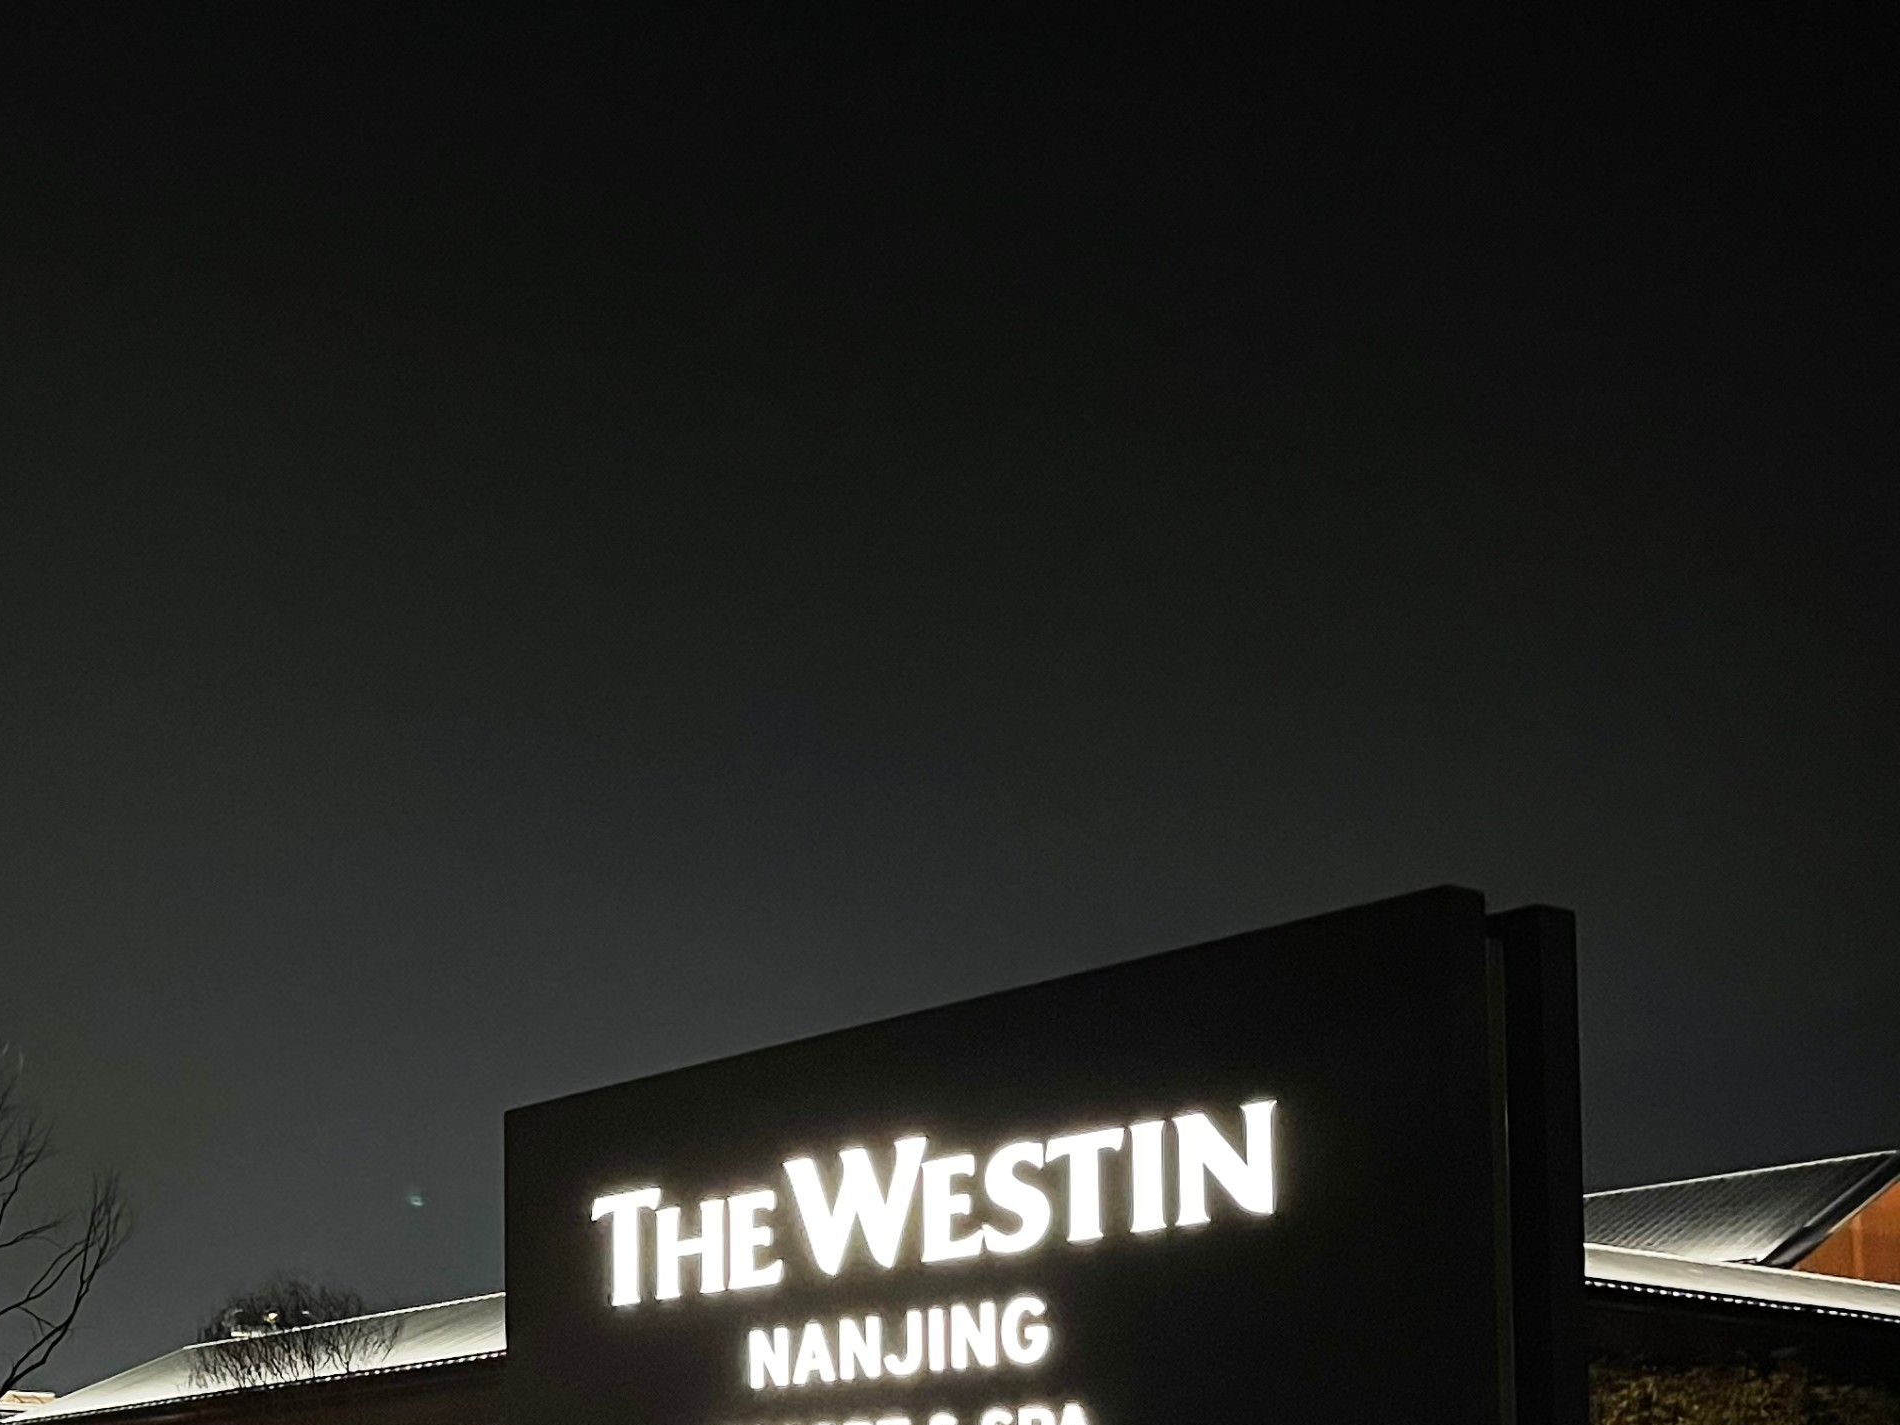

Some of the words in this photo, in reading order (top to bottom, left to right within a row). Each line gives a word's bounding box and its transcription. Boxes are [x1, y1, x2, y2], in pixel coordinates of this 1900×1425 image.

[590, 1185, 784, 1308] THE
[782, 1099, 1278, 1279] WESTIN
[746, 1292, 1052, 1392] NANJING
